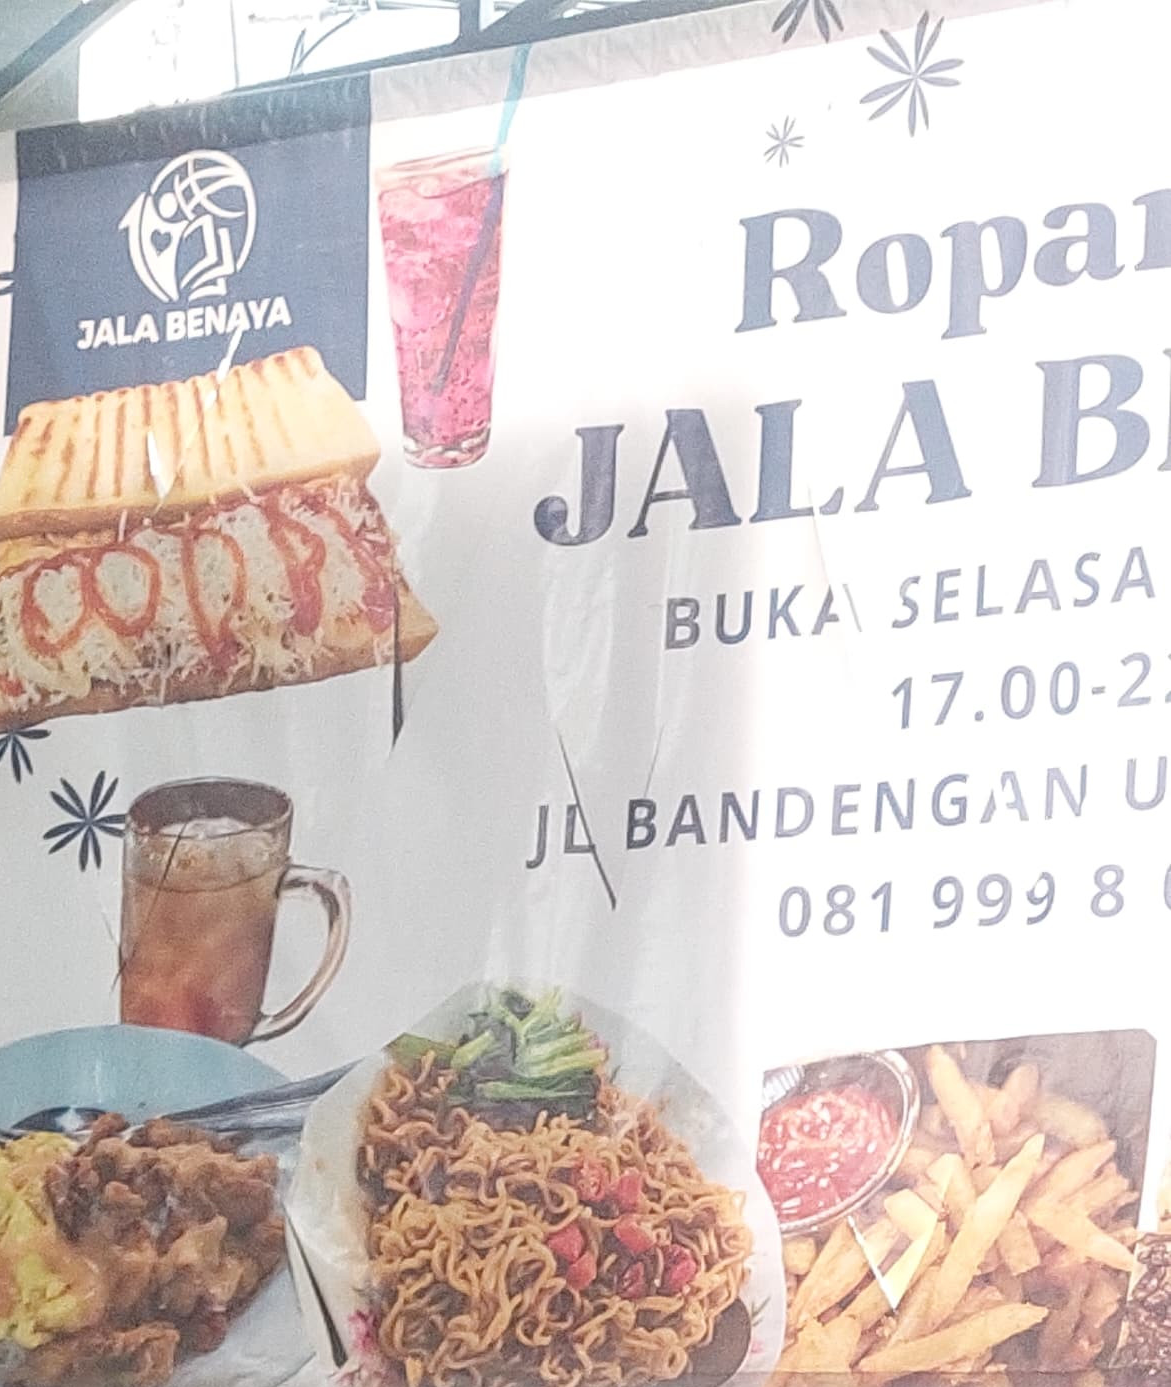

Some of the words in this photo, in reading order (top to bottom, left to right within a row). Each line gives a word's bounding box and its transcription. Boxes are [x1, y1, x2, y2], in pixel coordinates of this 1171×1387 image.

[77, 313, 160, 351] JALA
[165, 295, 292, 342] BENAYA
[533, 378, 972, 547] JALA
[1032, 346, 1171, 488] B
[664, 583, 862, 650] BUKA
[892, 547, 1156, 631] SELASA
[891, 651, 1171, 730] 17.00-2
[626, 764, 1088, 850] BANDENGAN
[778, 880, 892, 938] 081
[932, 870, 1056, 930] 999
[1090, 863, 1126, 918] 8
